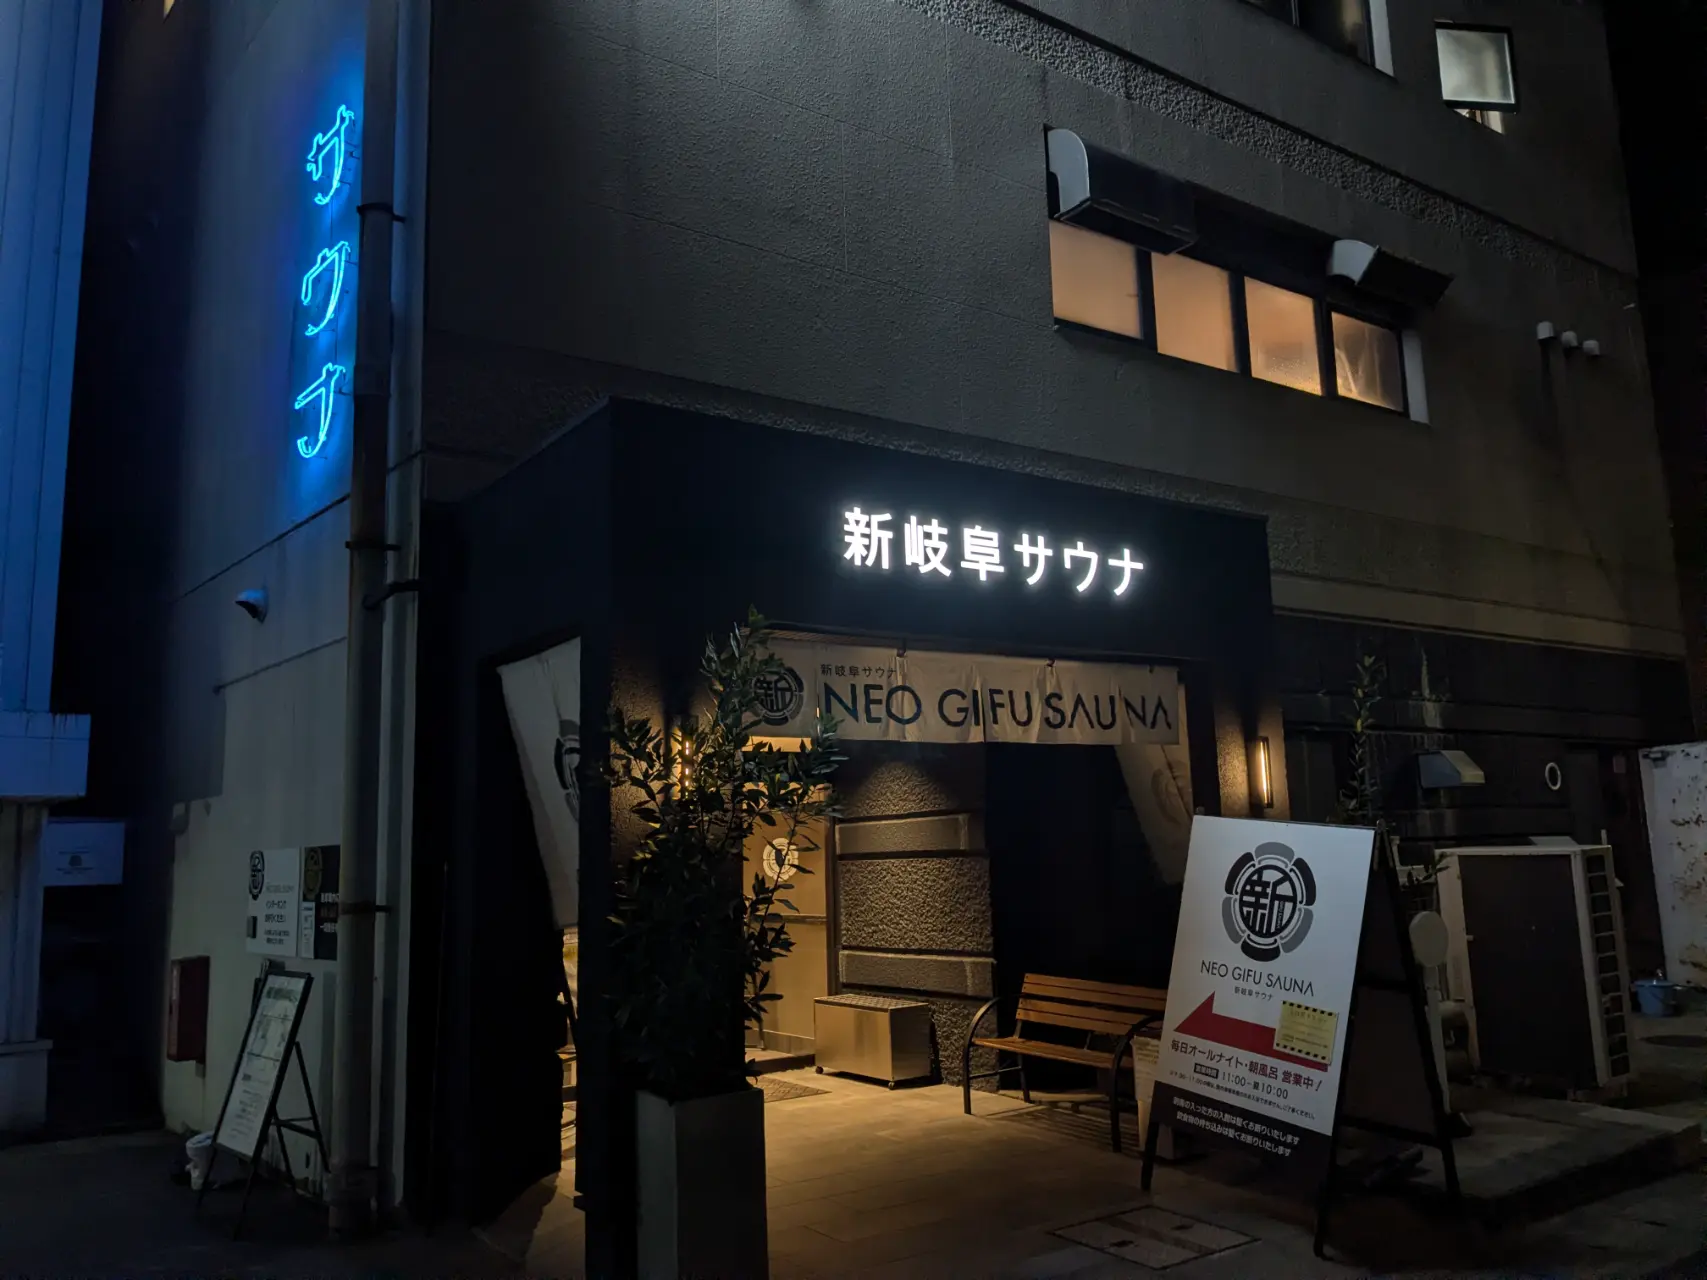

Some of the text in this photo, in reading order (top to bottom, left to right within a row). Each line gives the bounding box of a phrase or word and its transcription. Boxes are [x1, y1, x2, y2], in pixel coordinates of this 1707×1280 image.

[295, 104, 354, 459] サウナ
[843, 507, 1144, 596] 新岐阜サウナ
[820, 663, 897, 679] 新岐阜サウナ
[824, 682, 1172, 730] NEO GIFU SAUNA
[1201, 959, 1314, 997] NEO GIFU SAUNA
[1234, 986, 1274, 1001] 新岐阜サウナ
